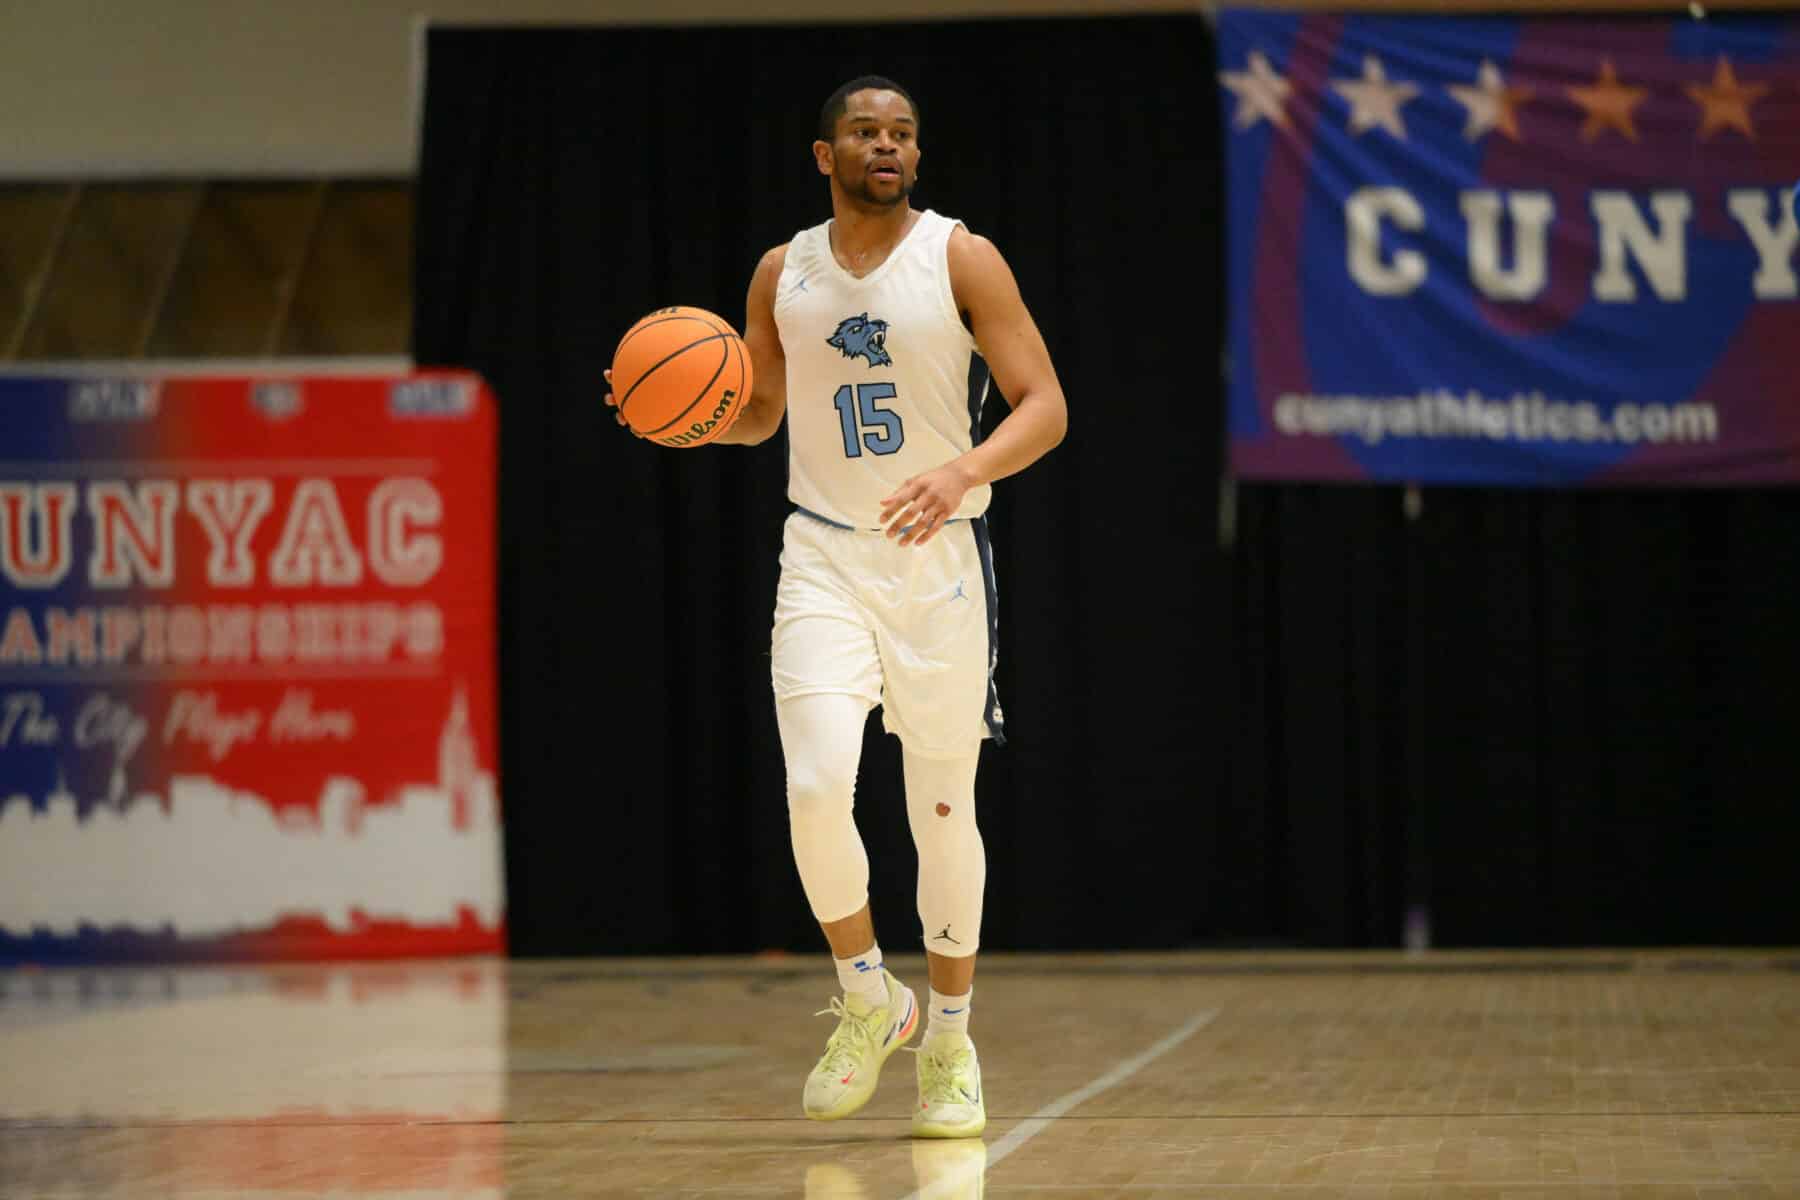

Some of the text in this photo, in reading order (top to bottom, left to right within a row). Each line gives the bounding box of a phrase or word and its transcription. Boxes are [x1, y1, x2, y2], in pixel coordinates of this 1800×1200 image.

[1345, 185, 1800, 300] CUNY
[657, 389, 736, 446] Wilson
[833, 382, 905, 458] 15
[1274, 388, 1718, 446] cunyathletics.com
[0, 476, 445, 589] UNYAC
[74, 688, 149, 763] City
[163, 687, 262, 763] Plays
[270, 687, 357, 745] Here
